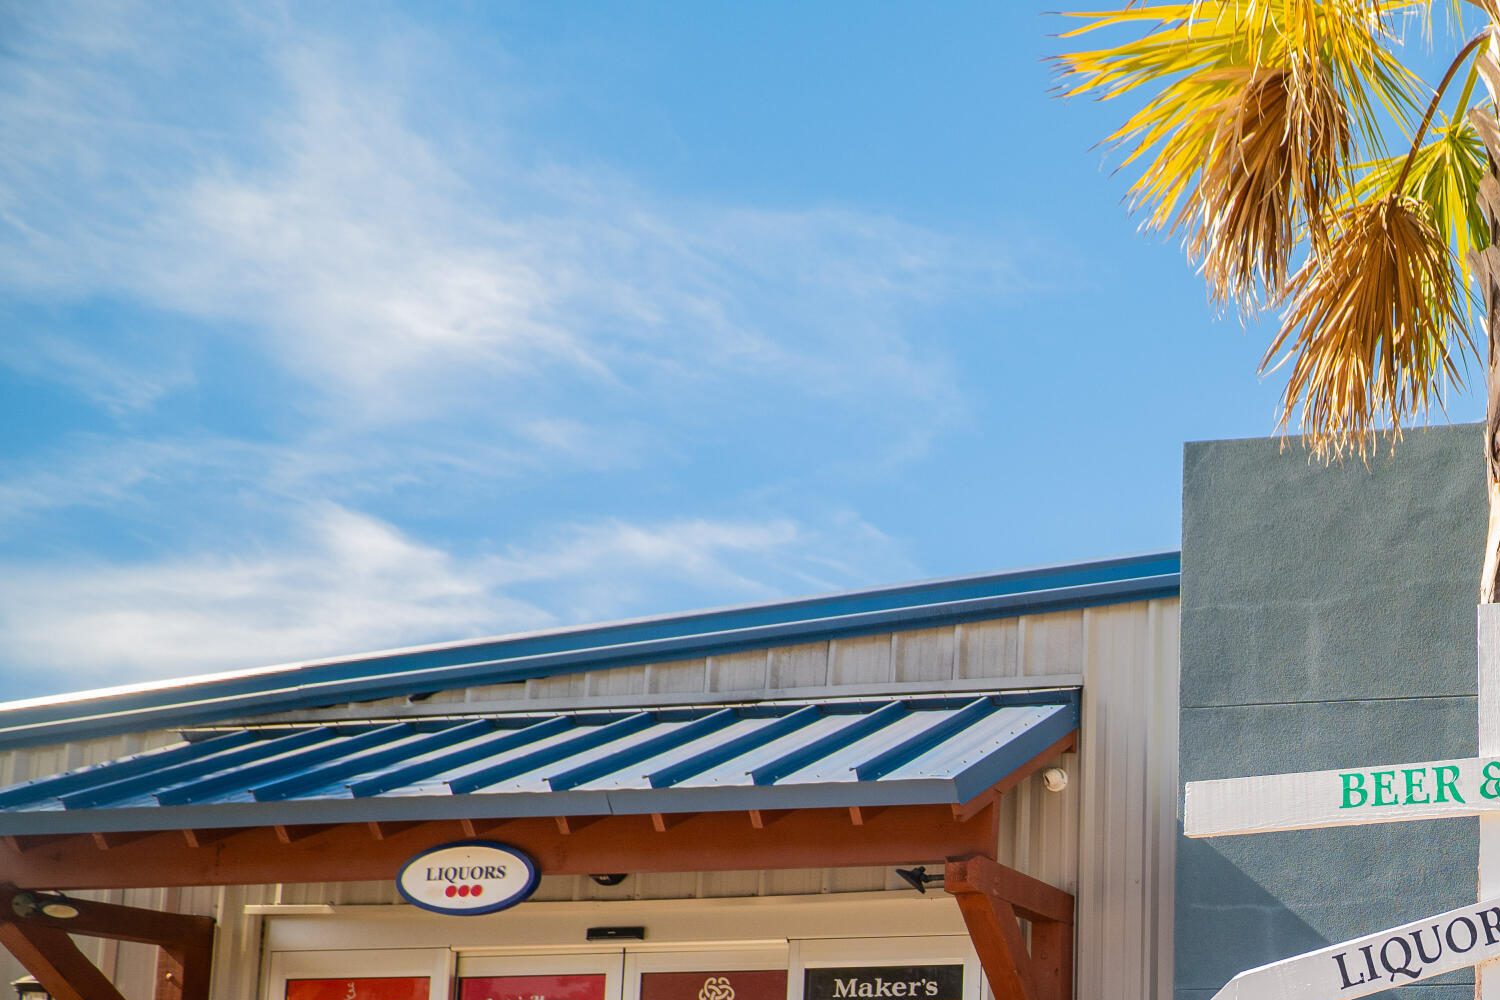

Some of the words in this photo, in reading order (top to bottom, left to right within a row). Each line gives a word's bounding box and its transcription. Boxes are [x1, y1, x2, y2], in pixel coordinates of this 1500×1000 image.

[1338, 760, 1465, 810] BEER
[426, 865, 507, 884] LIQUORS
[832, 978, 939, 998] Maker's
